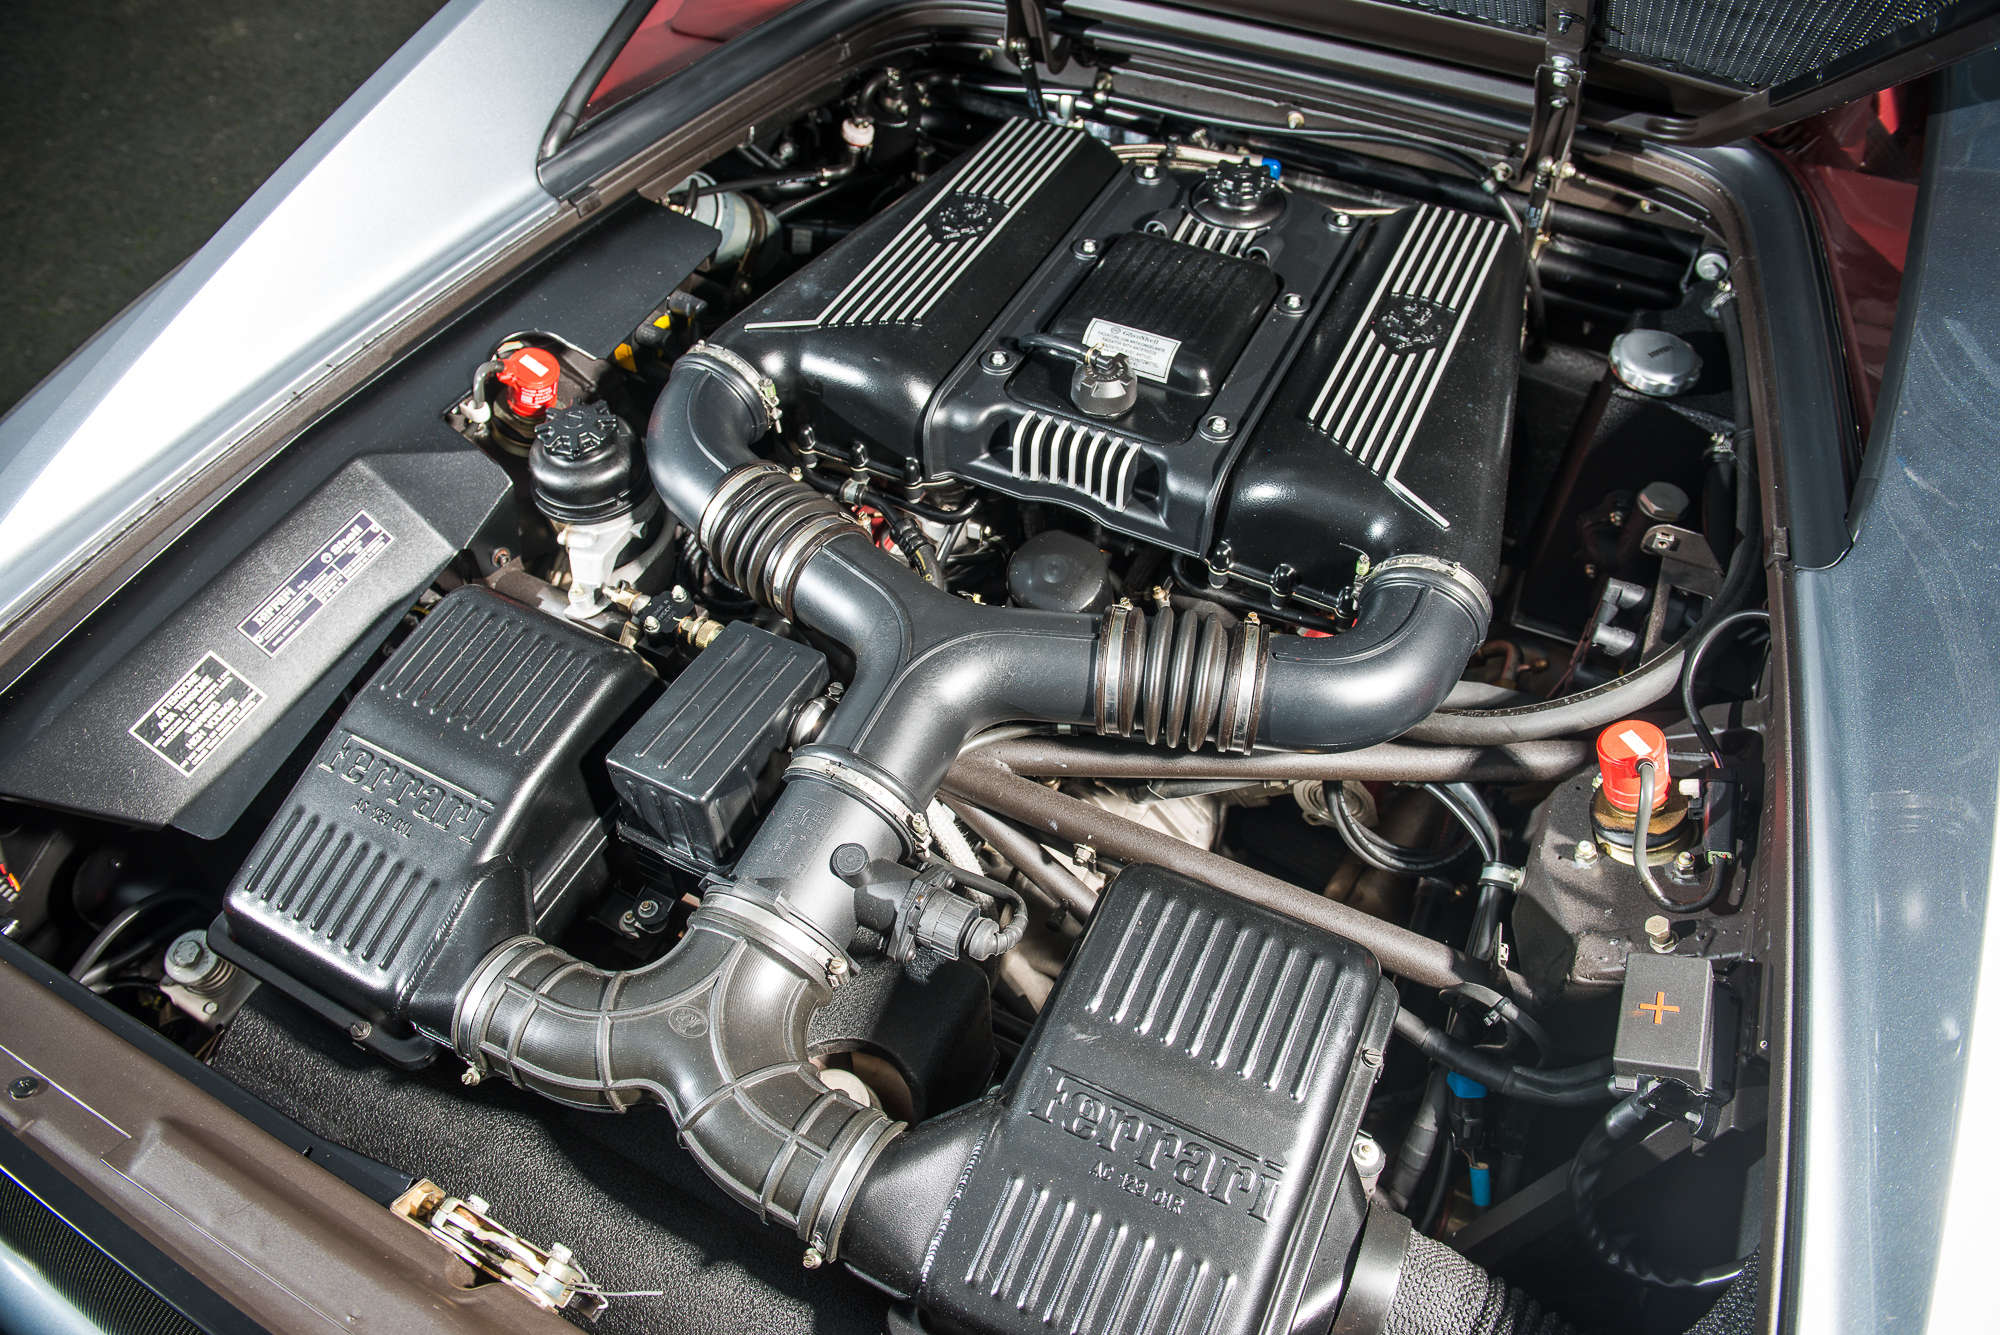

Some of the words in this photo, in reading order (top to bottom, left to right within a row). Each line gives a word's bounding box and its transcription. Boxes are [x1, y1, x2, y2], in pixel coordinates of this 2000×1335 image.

[330, 524, 363, 555] Shell
[251, 584, 297, 627] Ferrari
[184, 700, 221, 735] WARNING
[185, 728, 207, 750] HIGH
[204, 696, 238, 730] VOLTAGE
[317, 729, 496, 846] Ferrari
[1027, 1064, 1287, 1224] Ferrari
[1089, 1160, 1115, 1181] AC
[1118, 1171, 1149, 1197] 129
